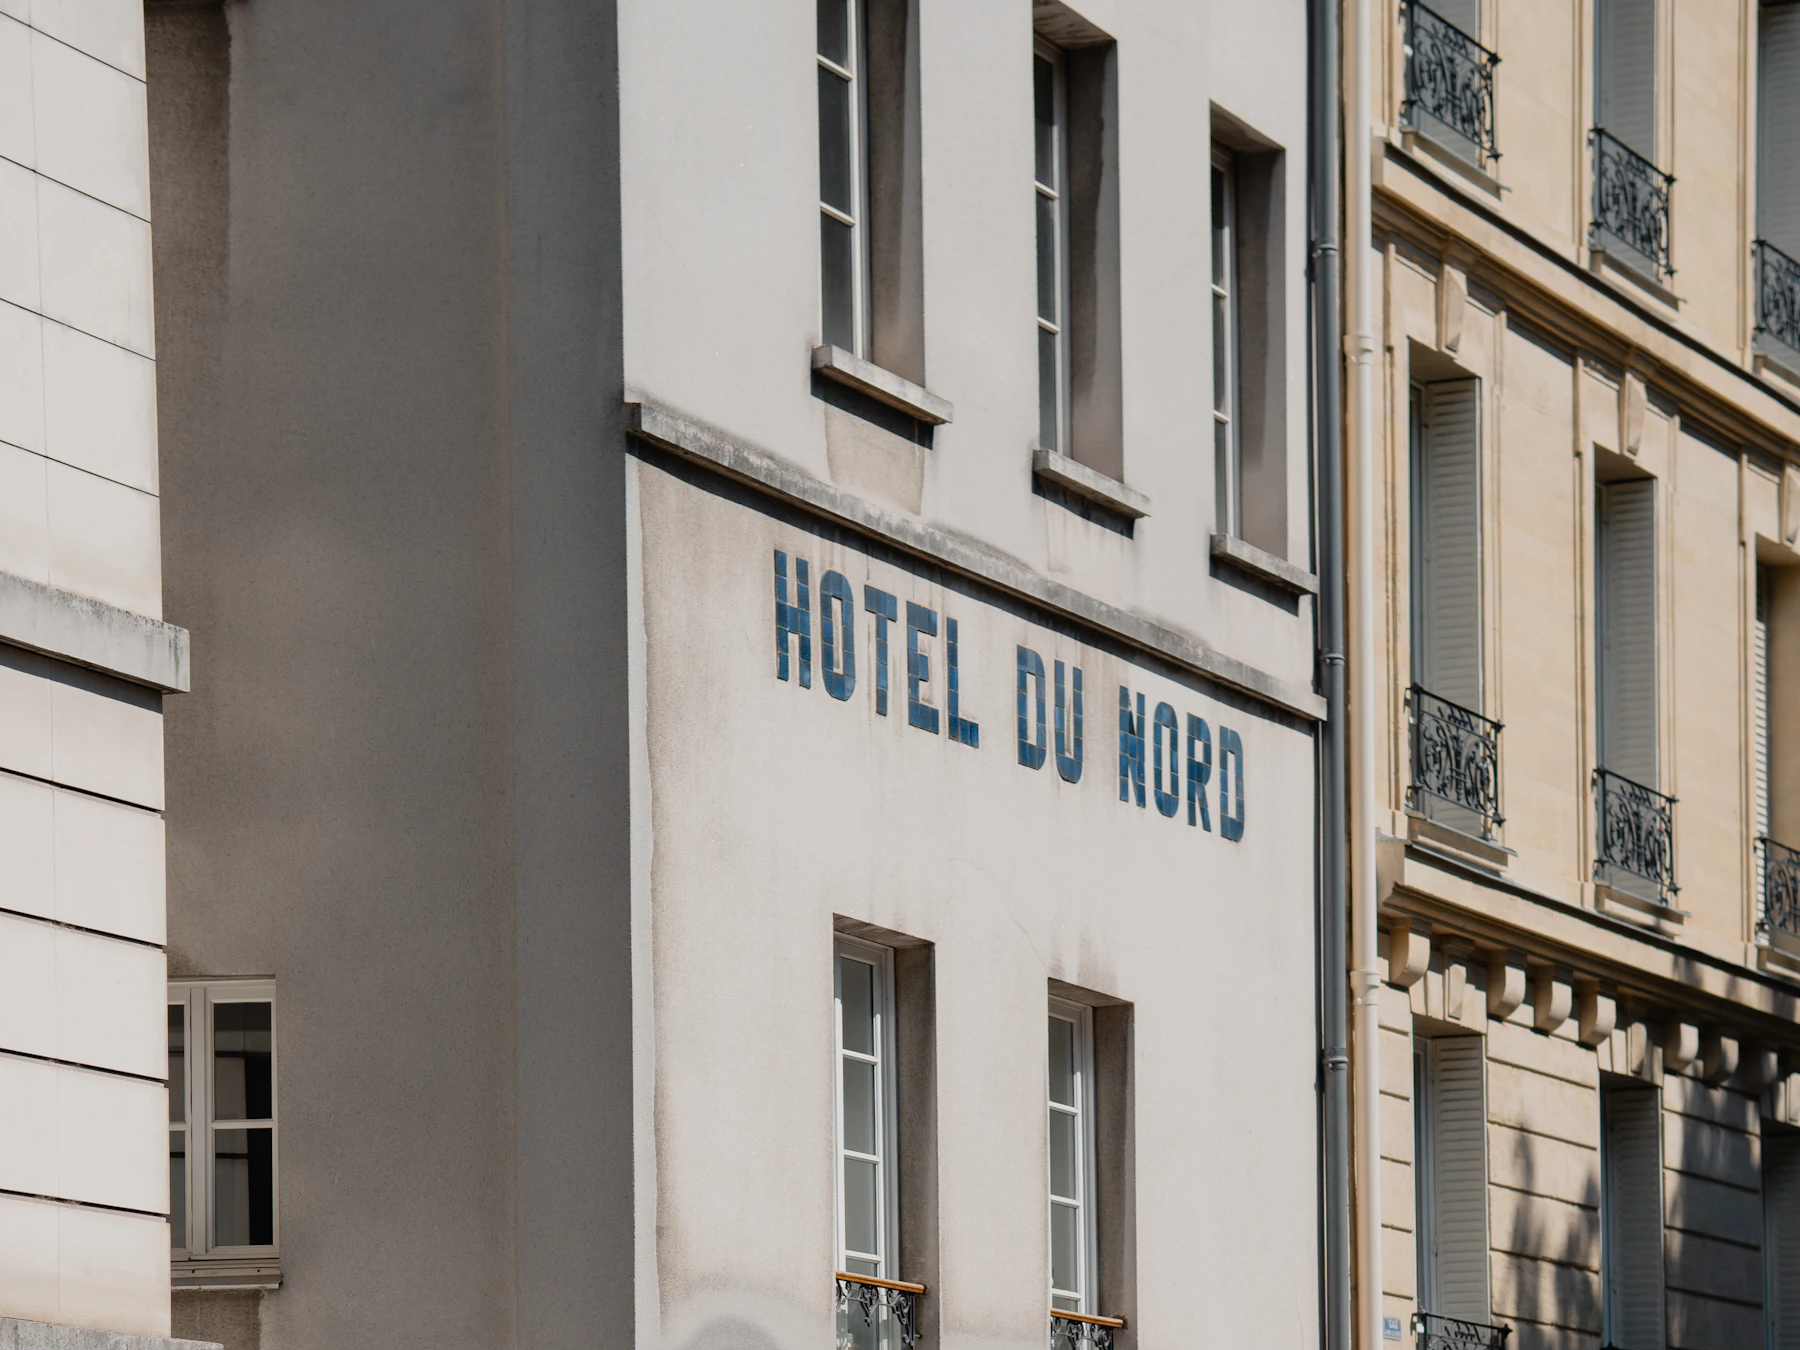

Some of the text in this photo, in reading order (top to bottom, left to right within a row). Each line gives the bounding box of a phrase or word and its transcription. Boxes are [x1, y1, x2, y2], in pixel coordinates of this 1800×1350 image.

[773, 548, 1245, 843] HOTEL DU NORD
